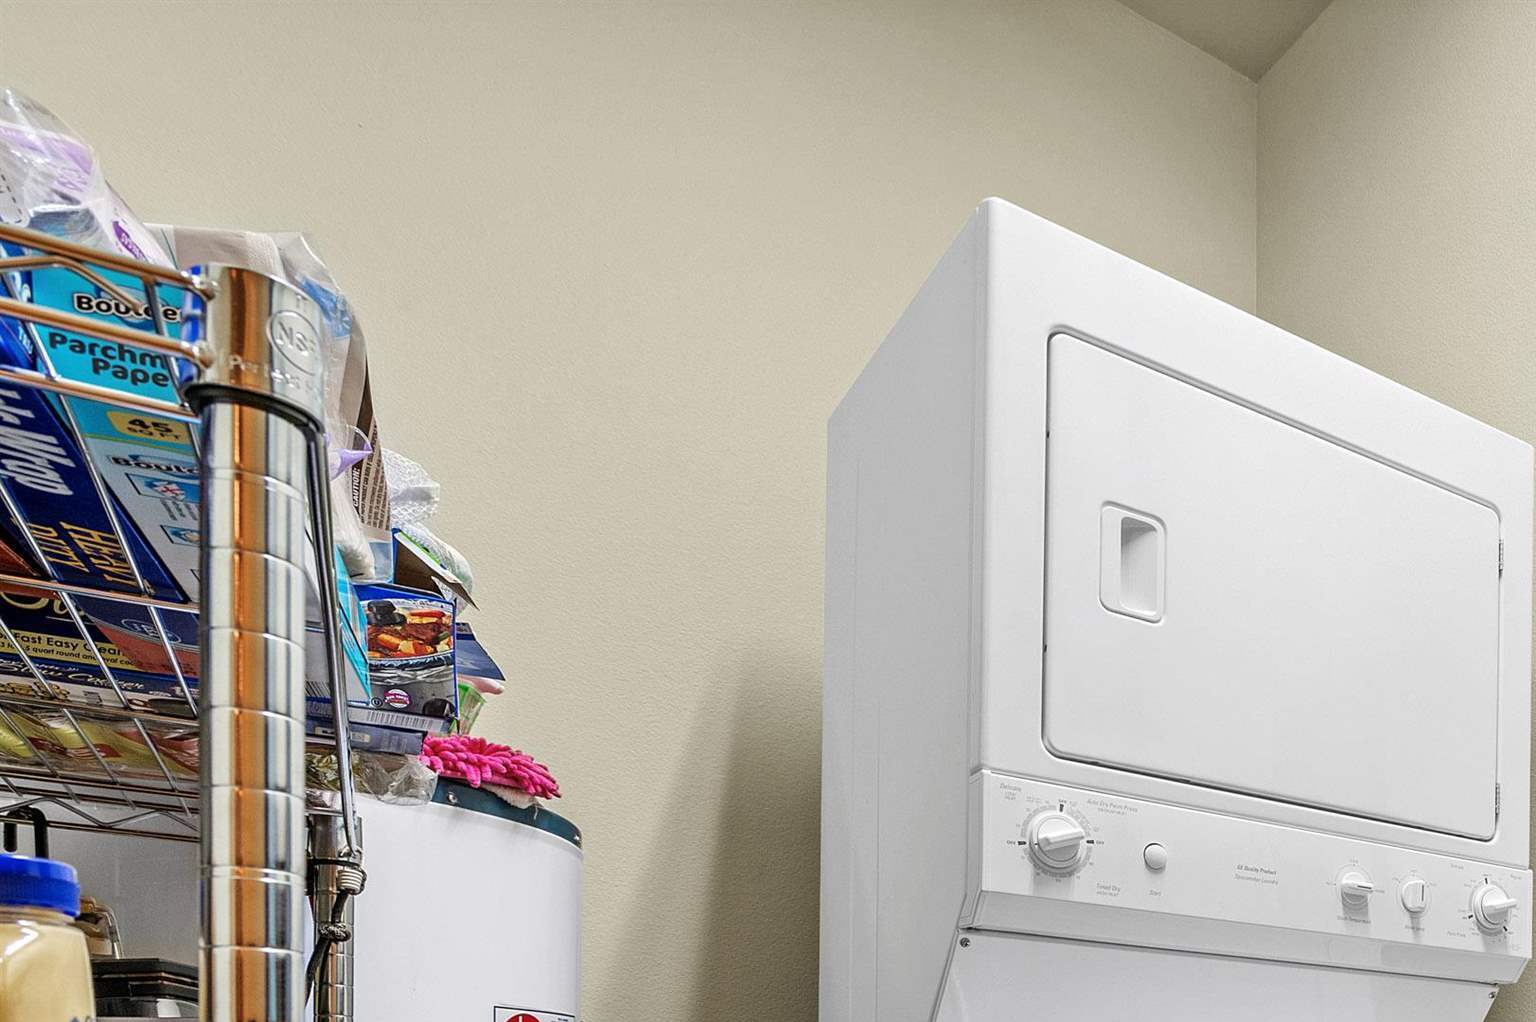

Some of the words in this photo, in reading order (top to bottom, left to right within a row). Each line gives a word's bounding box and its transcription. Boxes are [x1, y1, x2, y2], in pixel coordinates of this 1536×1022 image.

[49, 332, 168, 369] Parchm
[92, 358, 170, 388] Pape
[128, 418, 172, 433] 45
[352, 467, 361, 507] CAUTION:
[46, 636, 79, 652] Easy
